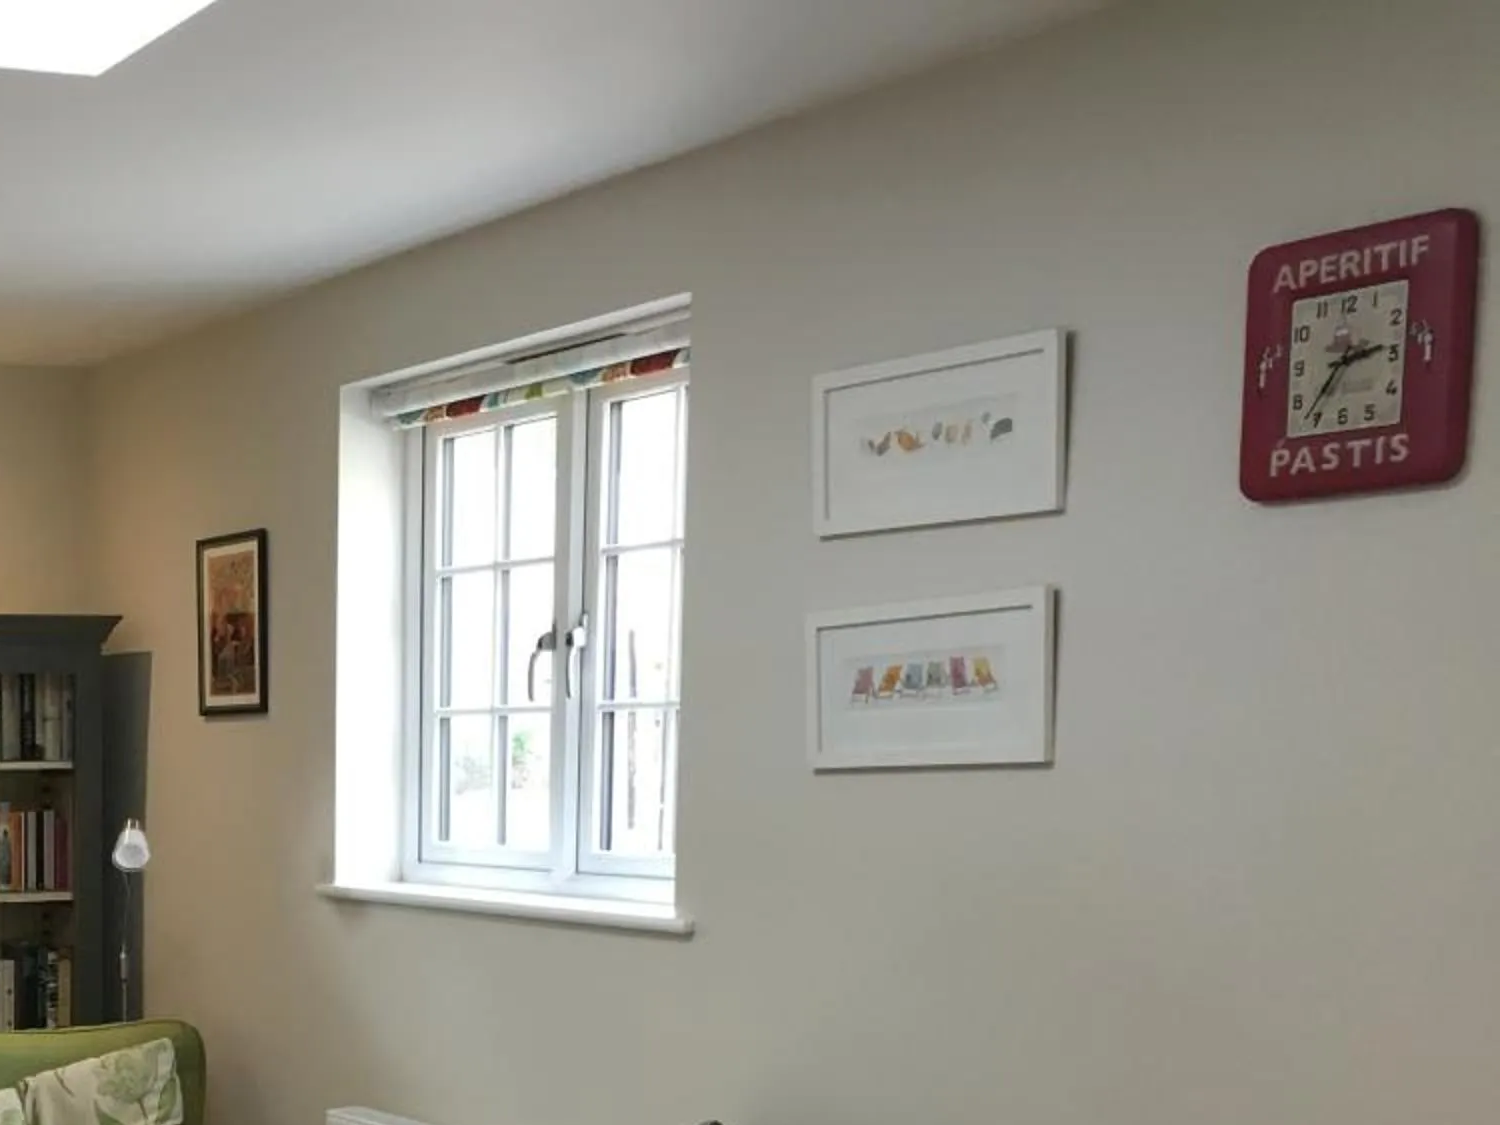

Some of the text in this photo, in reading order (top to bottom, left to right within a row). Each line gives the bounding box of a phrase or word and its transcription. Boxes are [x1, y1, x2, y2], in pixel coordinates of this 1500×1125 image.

[1273, 235, 1430, 293] APERITIF
[1316, 302, 1328, 318] 11
[1341, 296, 1357, 313] 12
[1390, 309, 1402, 326] 2
[1293, 326, 1310, 342] 10
[1294, 361, 1304, 377] 9
[1385, 380, 1397, 396] 4
[1293, 394, 1303, 410] 8
[1337, 408, 1348, 425] 6
[1364, 405, 1375, 421] 5
[1270, 433, 1410, 478] PASTIS
